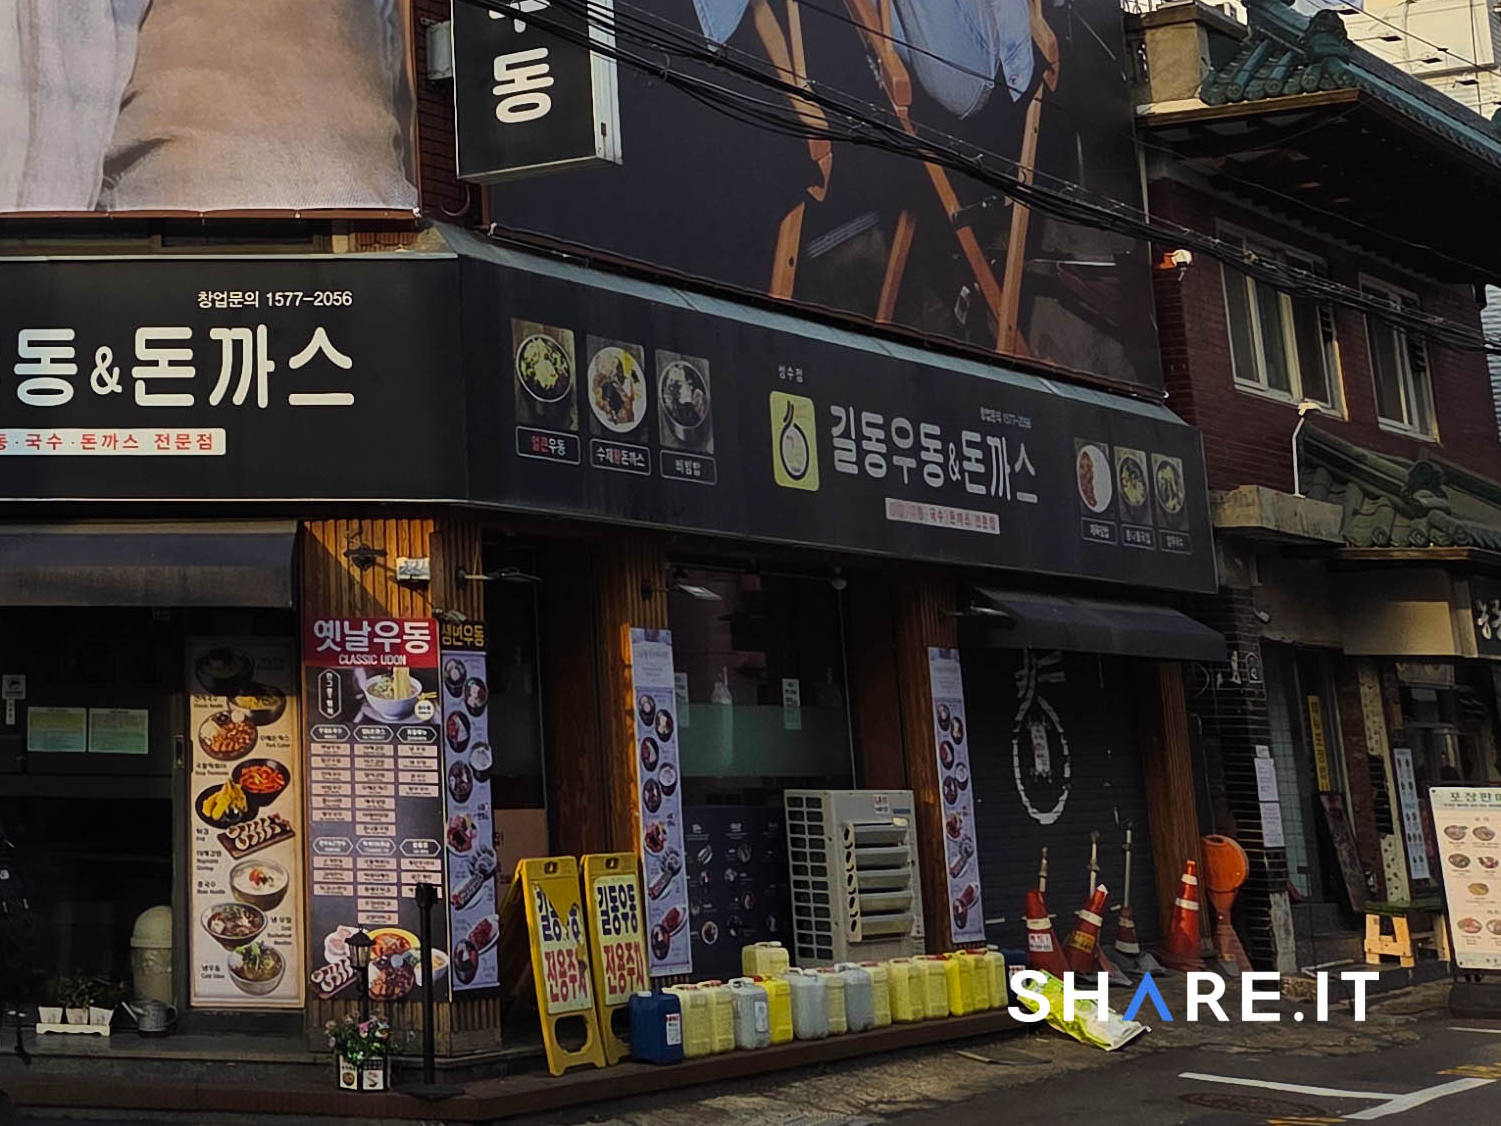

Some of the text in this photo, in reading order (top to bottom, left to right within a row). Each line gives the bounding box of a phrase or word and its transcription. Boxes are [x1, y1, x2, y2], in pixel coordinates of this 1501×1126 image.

[197, 290, 353, 308] 창업문의 1577-2056
[25, 433, 64, 451] 국수
[79, 433, 140, 451] 돈까스
[153, 433, 214, 451] 전문점
[313, 619, 432, 654] 옛날우동
[338, 654, 407, 665] CLASSIC UDON
[536, 890, 581, 942] 길동동
[597, 884, 638, 936] 길동우동
[602, 940, 645, 995] 전용주차
